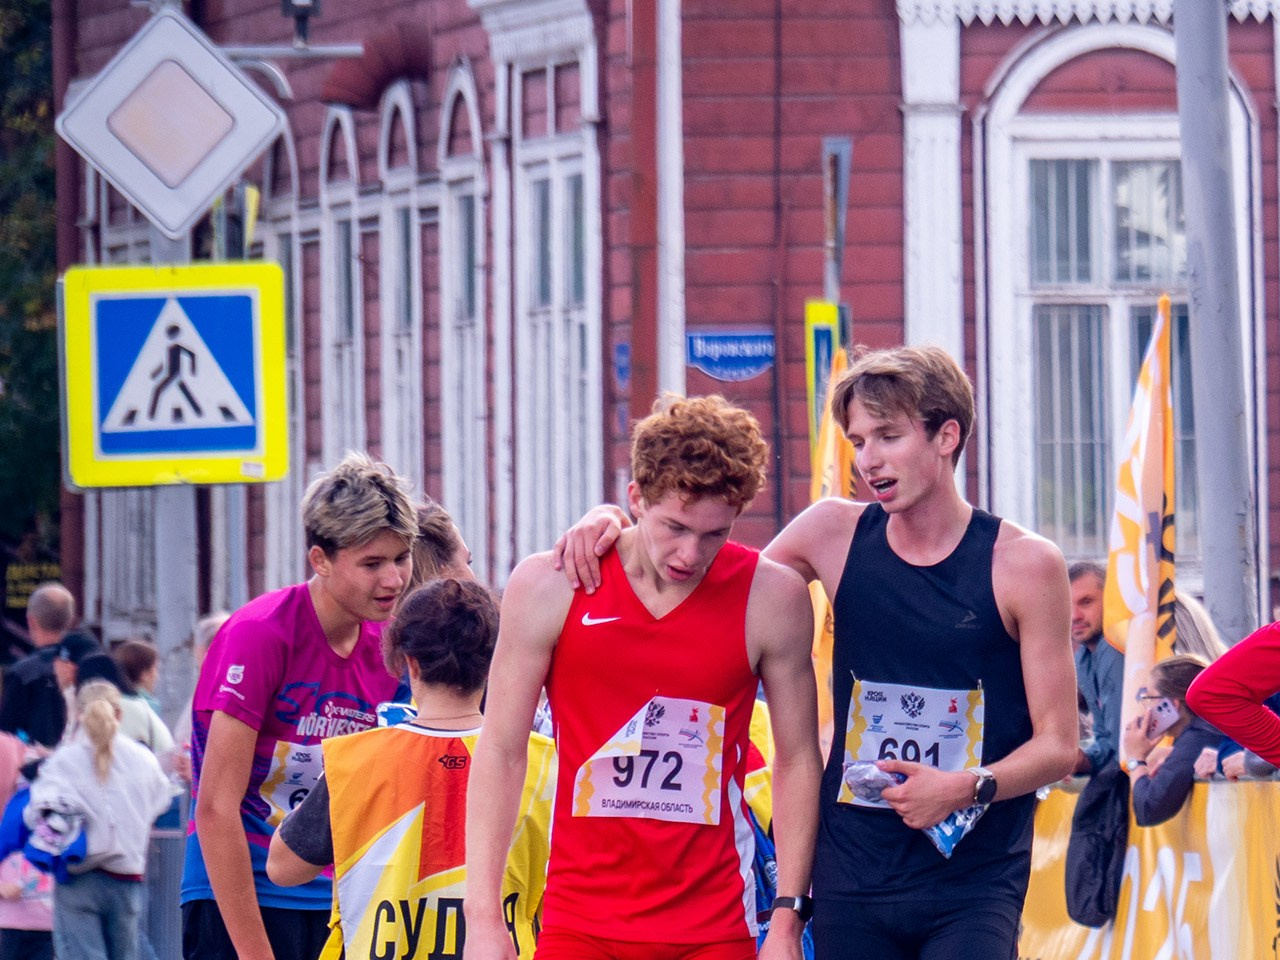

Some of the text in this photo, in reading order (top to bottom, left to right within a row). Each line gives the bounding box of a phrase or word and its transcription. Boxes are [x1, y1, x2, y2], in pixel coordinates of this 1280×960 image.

[878, 737, 940, 768] 691
[612, 749, 684, 791] 972
[601, 798, 694, 814] ВЛАДИМИРСКАЯ ОБЛАСТЬ
